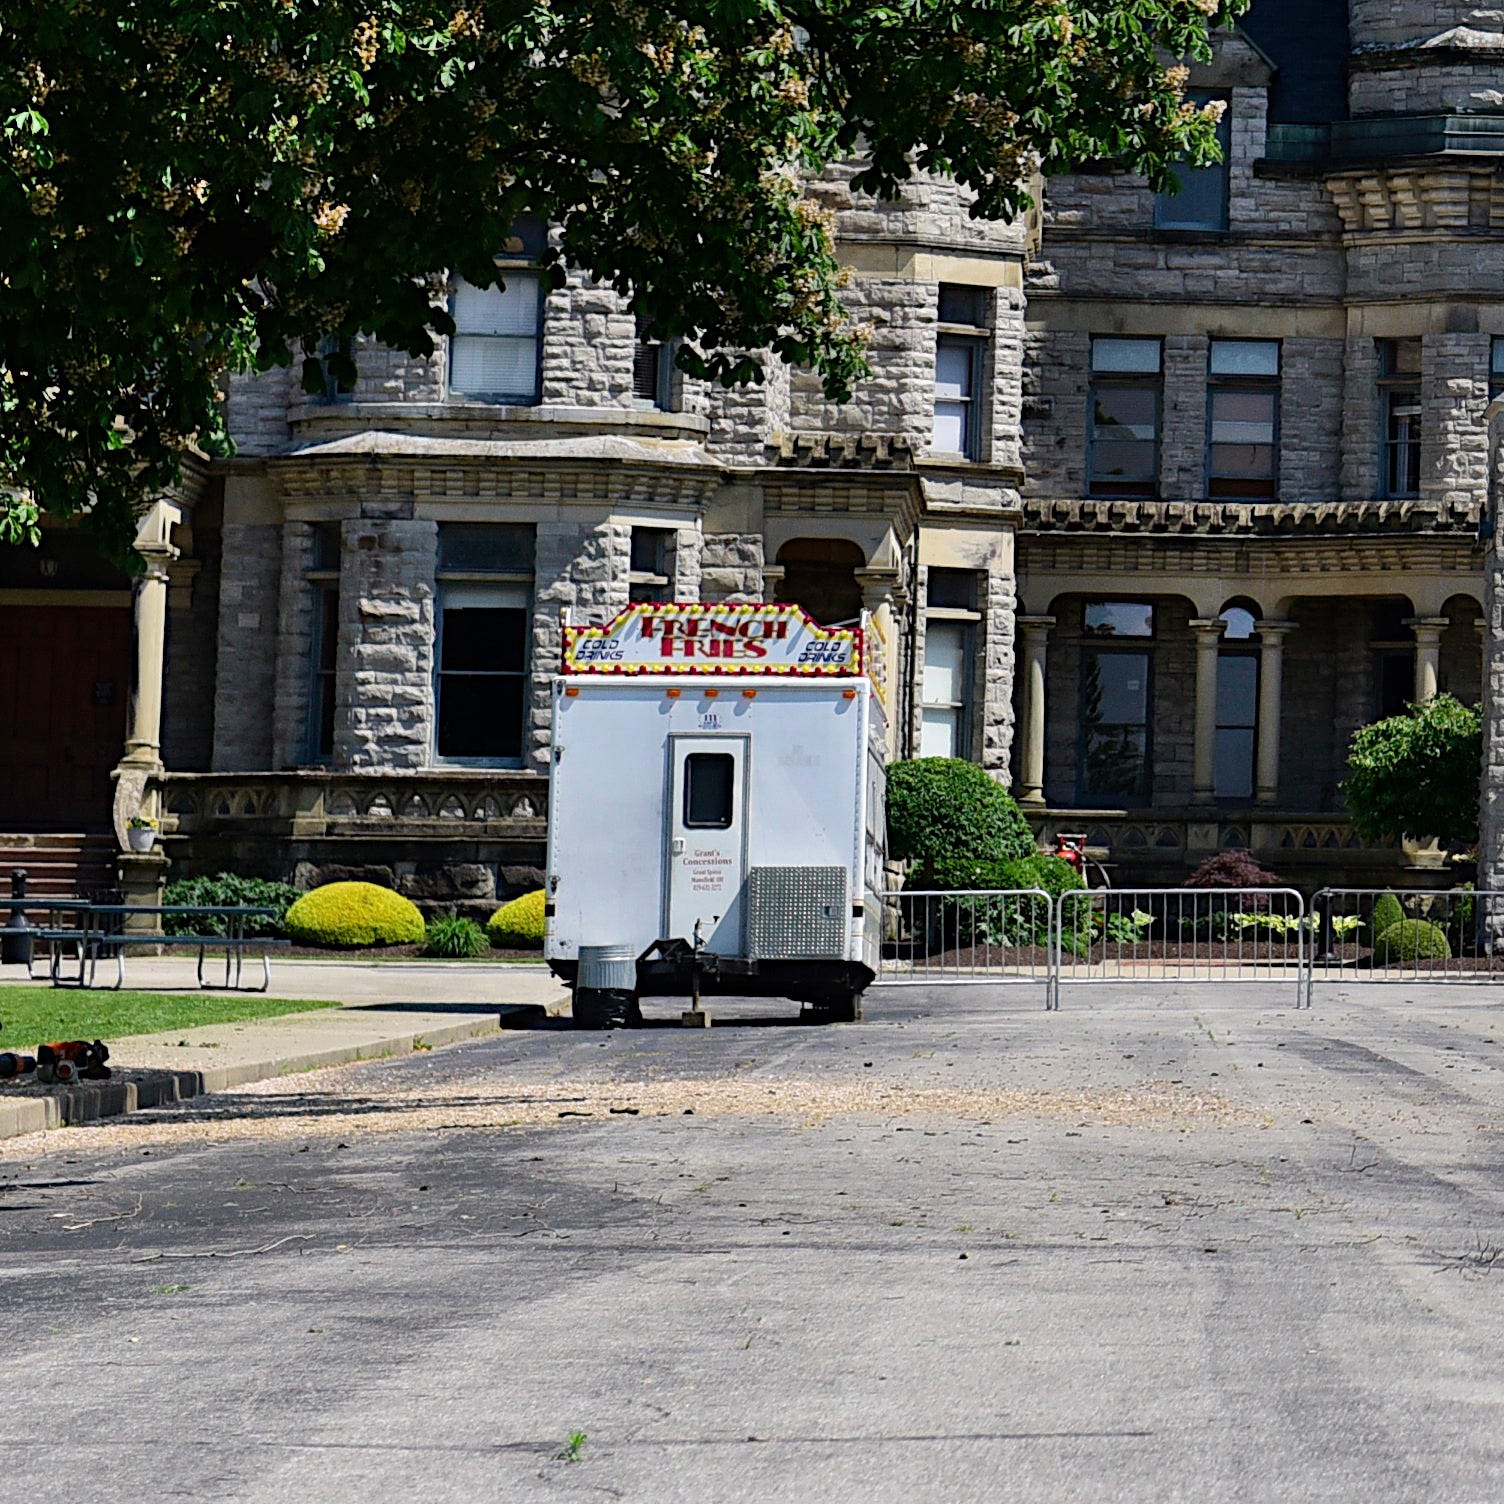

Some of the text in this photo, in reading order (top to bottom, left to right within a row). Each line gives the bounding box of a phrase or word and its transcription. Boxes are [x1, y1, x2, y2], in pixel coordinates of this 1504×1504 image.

[641, 615, 789, 640] FRENCH
[582, 639, 619, 650] COLD
[660, 637, 767, 658] FRIES
[805, 641, 841, 651] COLD
[575, 650, 624, 661] DRINKS
[798, 652, 847, 663] DRINKS
[694, 849, 720, 857] Grant's
[683, 857, 732, 865] Concessions
